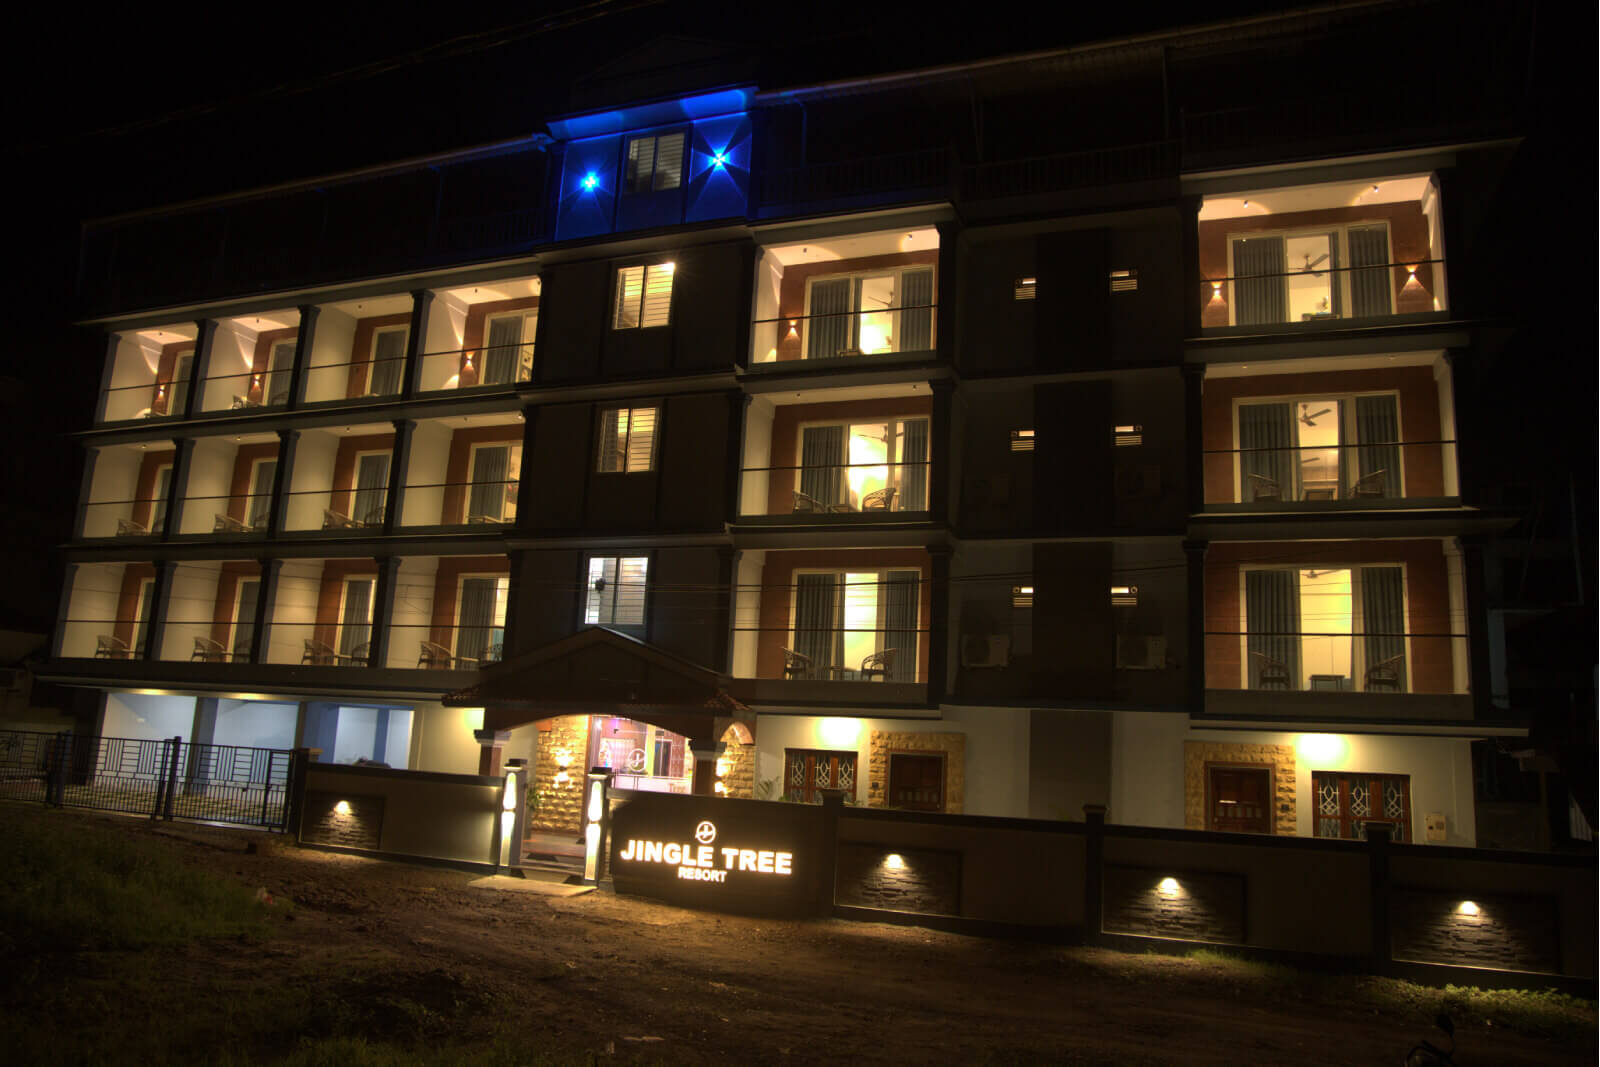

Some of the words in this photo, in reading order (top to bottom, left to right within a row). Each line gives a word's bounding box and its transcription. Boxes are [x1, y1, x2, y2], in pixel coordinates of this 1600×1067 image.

[620, 840, 713, 867] JINGLE
[721, 847, 792, 874] TREE
[678, 867, 727, 882] RESORT
